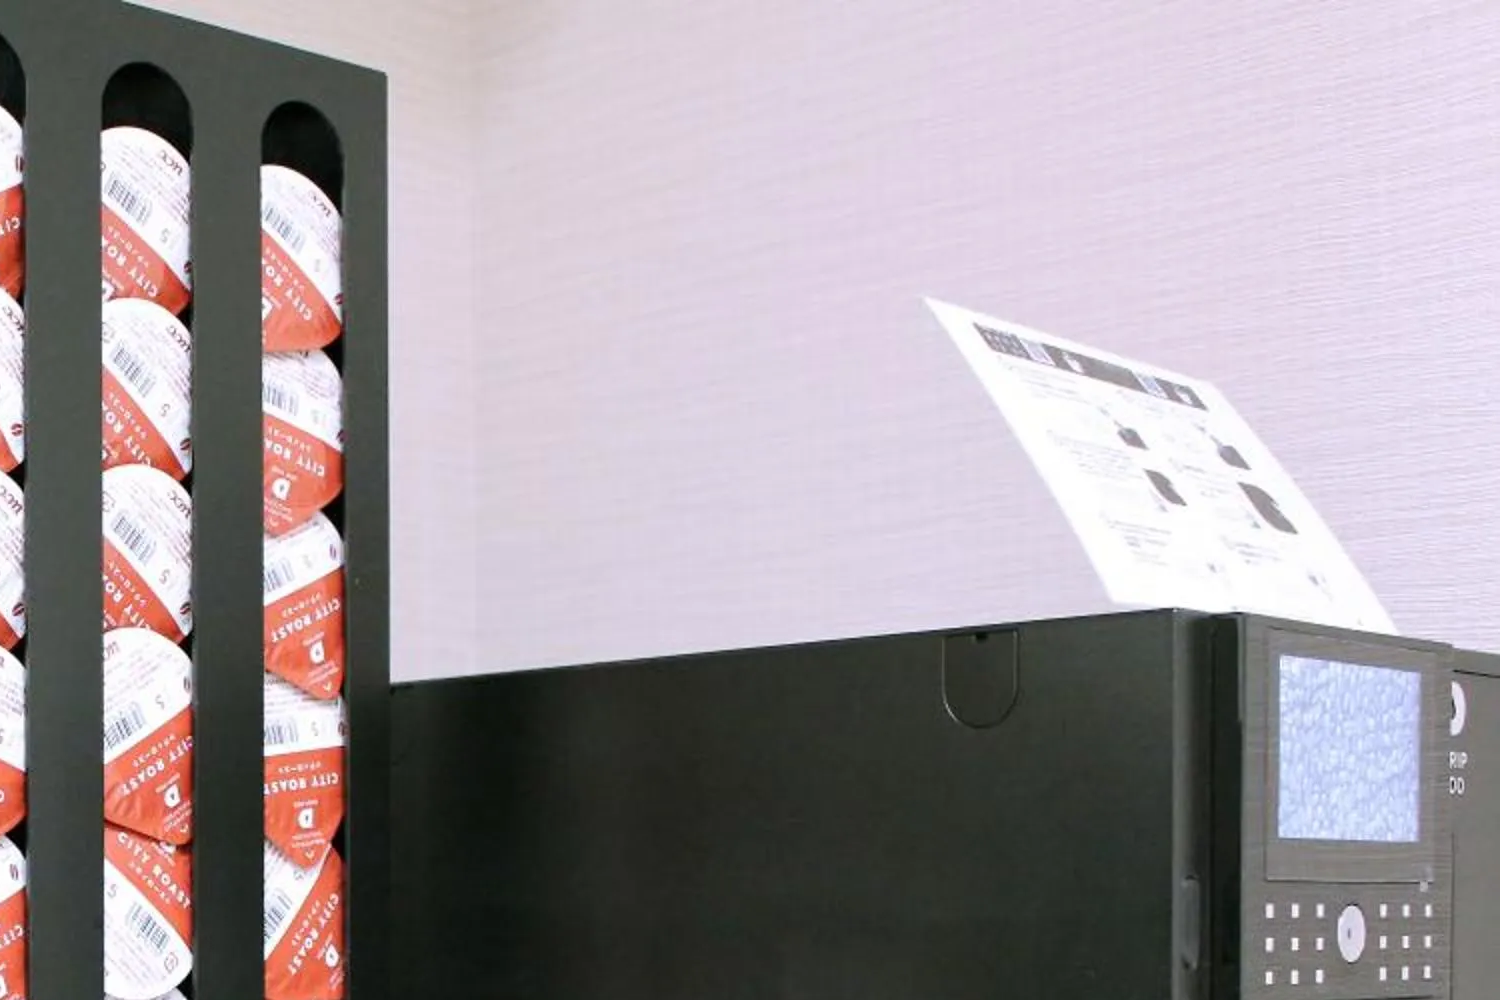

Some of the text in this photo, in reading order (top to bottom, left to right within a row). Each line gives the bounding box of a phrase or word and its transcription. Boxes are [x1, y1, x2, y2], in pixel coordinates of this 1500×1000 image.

[129, 266, 158, 297] CITY
[285, 287, 313, 322] CITY
[296, 454, 326, 477] CITY
[272, 597, 341, 643] CITY ROAST
[118, 757, 165, 796] ROAST
[1449, 751, 1468, 769] RIP
[264, 771, 339, 795] CITY ROAST
[1449, 776, 1465, 795] OD
[117, 832, 191, 909] CITY ROAST
[288, 893, 339, 975] CITY ROAST
